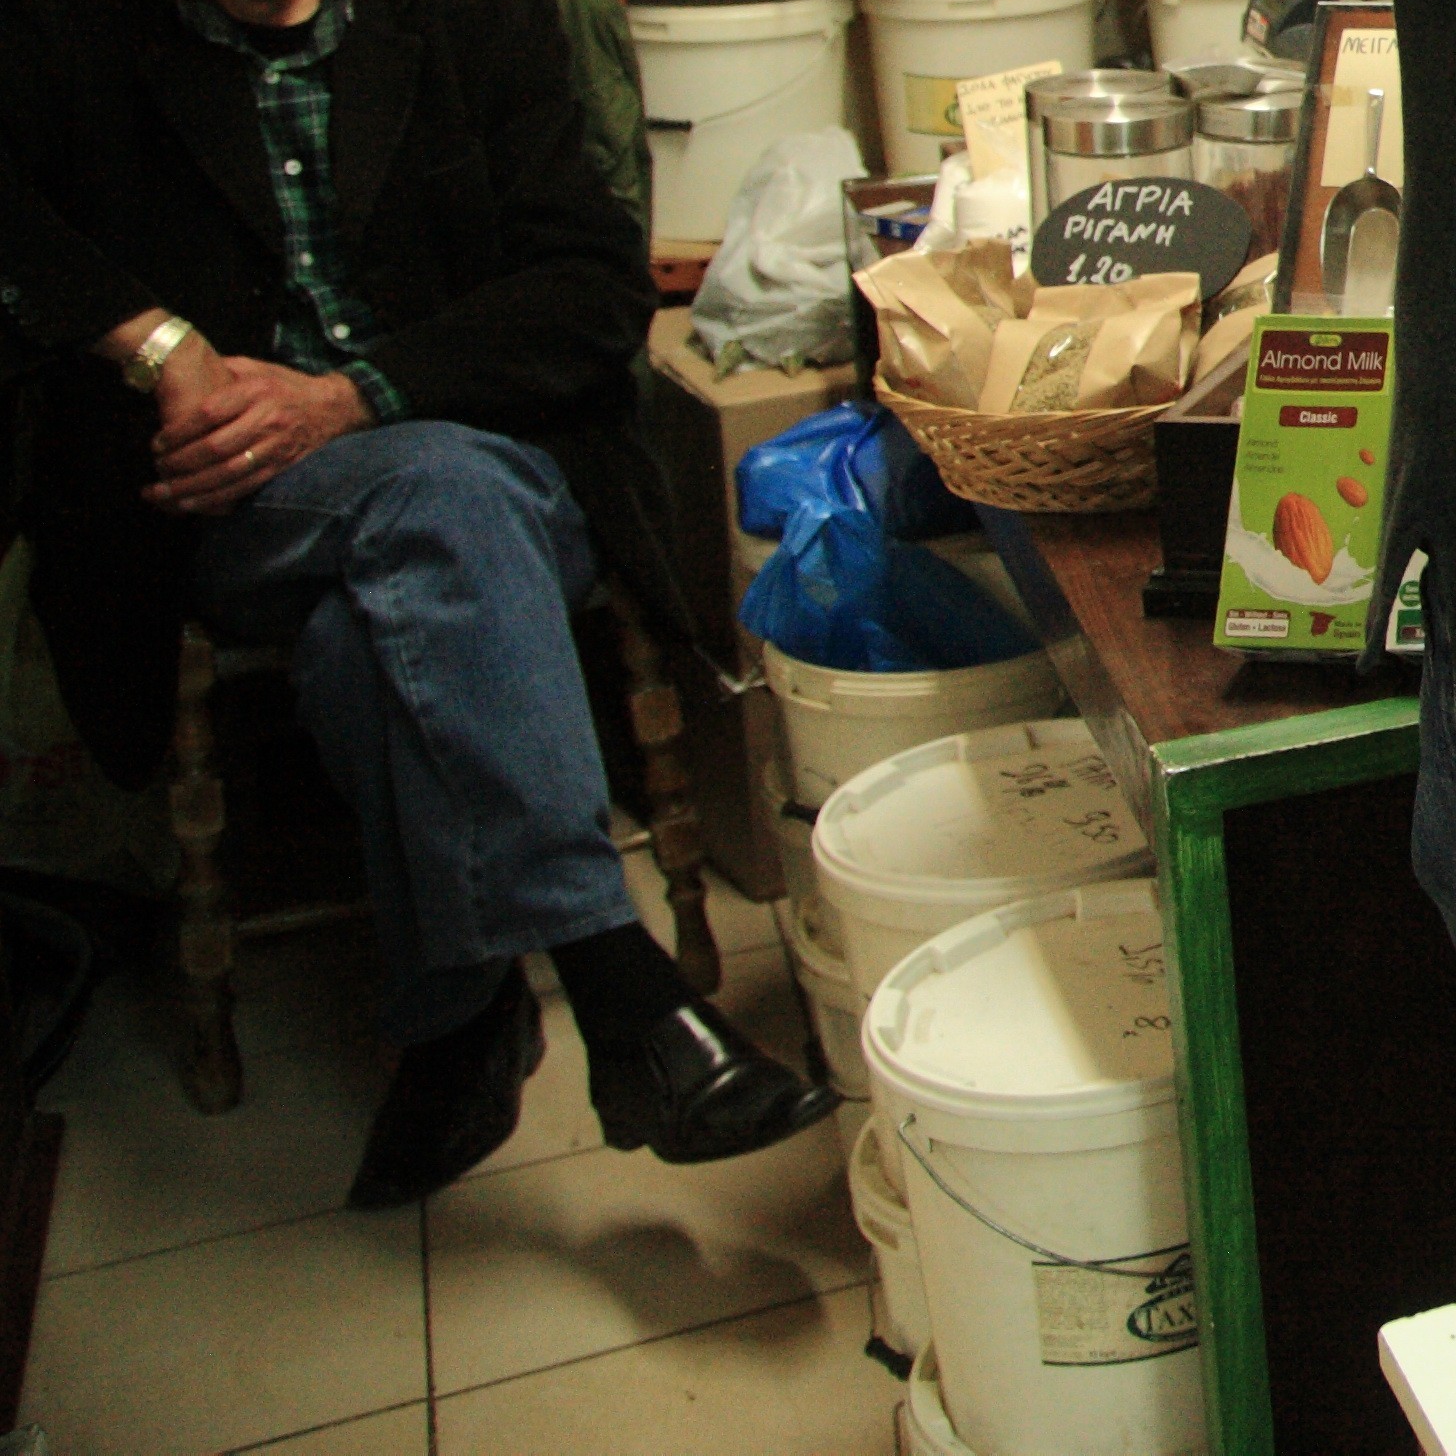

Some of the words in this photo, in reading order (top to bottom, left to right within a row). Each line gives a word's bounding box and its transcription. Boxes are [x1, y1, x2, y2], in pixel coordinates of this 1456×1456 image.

[1087, 182, 1194, 216] ΑΓΡΙΑ
[1063, 214, 1176, 247] ΡΙΓΑΝΗ
[1261, 349, 1343, 371] Almond
[1347, 351, 1384, 371] Milk
[1299, 410, 1339, 424] Classic
